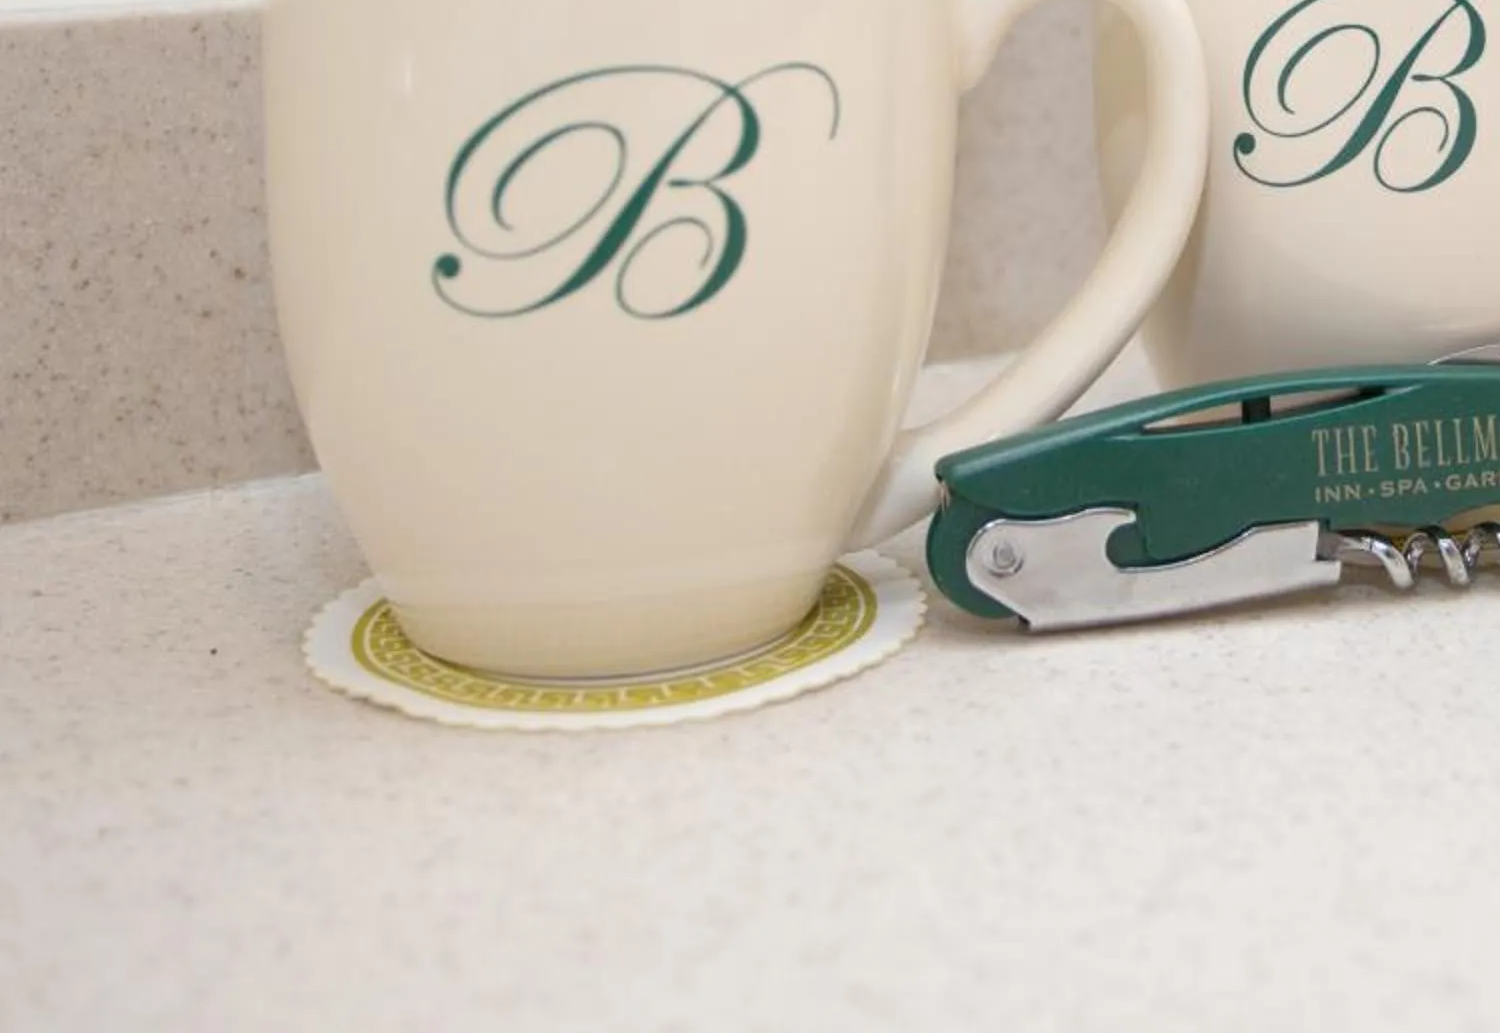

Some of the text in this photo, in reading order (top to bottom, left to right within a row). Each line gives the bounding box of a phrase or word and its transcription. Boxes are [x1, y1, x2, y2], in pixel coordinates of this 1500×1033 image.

[431, 62, 840, 320] B
[1311, 424, 1380, 477] THE
[1314, 484, 1361, 504] INN
[1380, 479, 1429, 499] SPA
